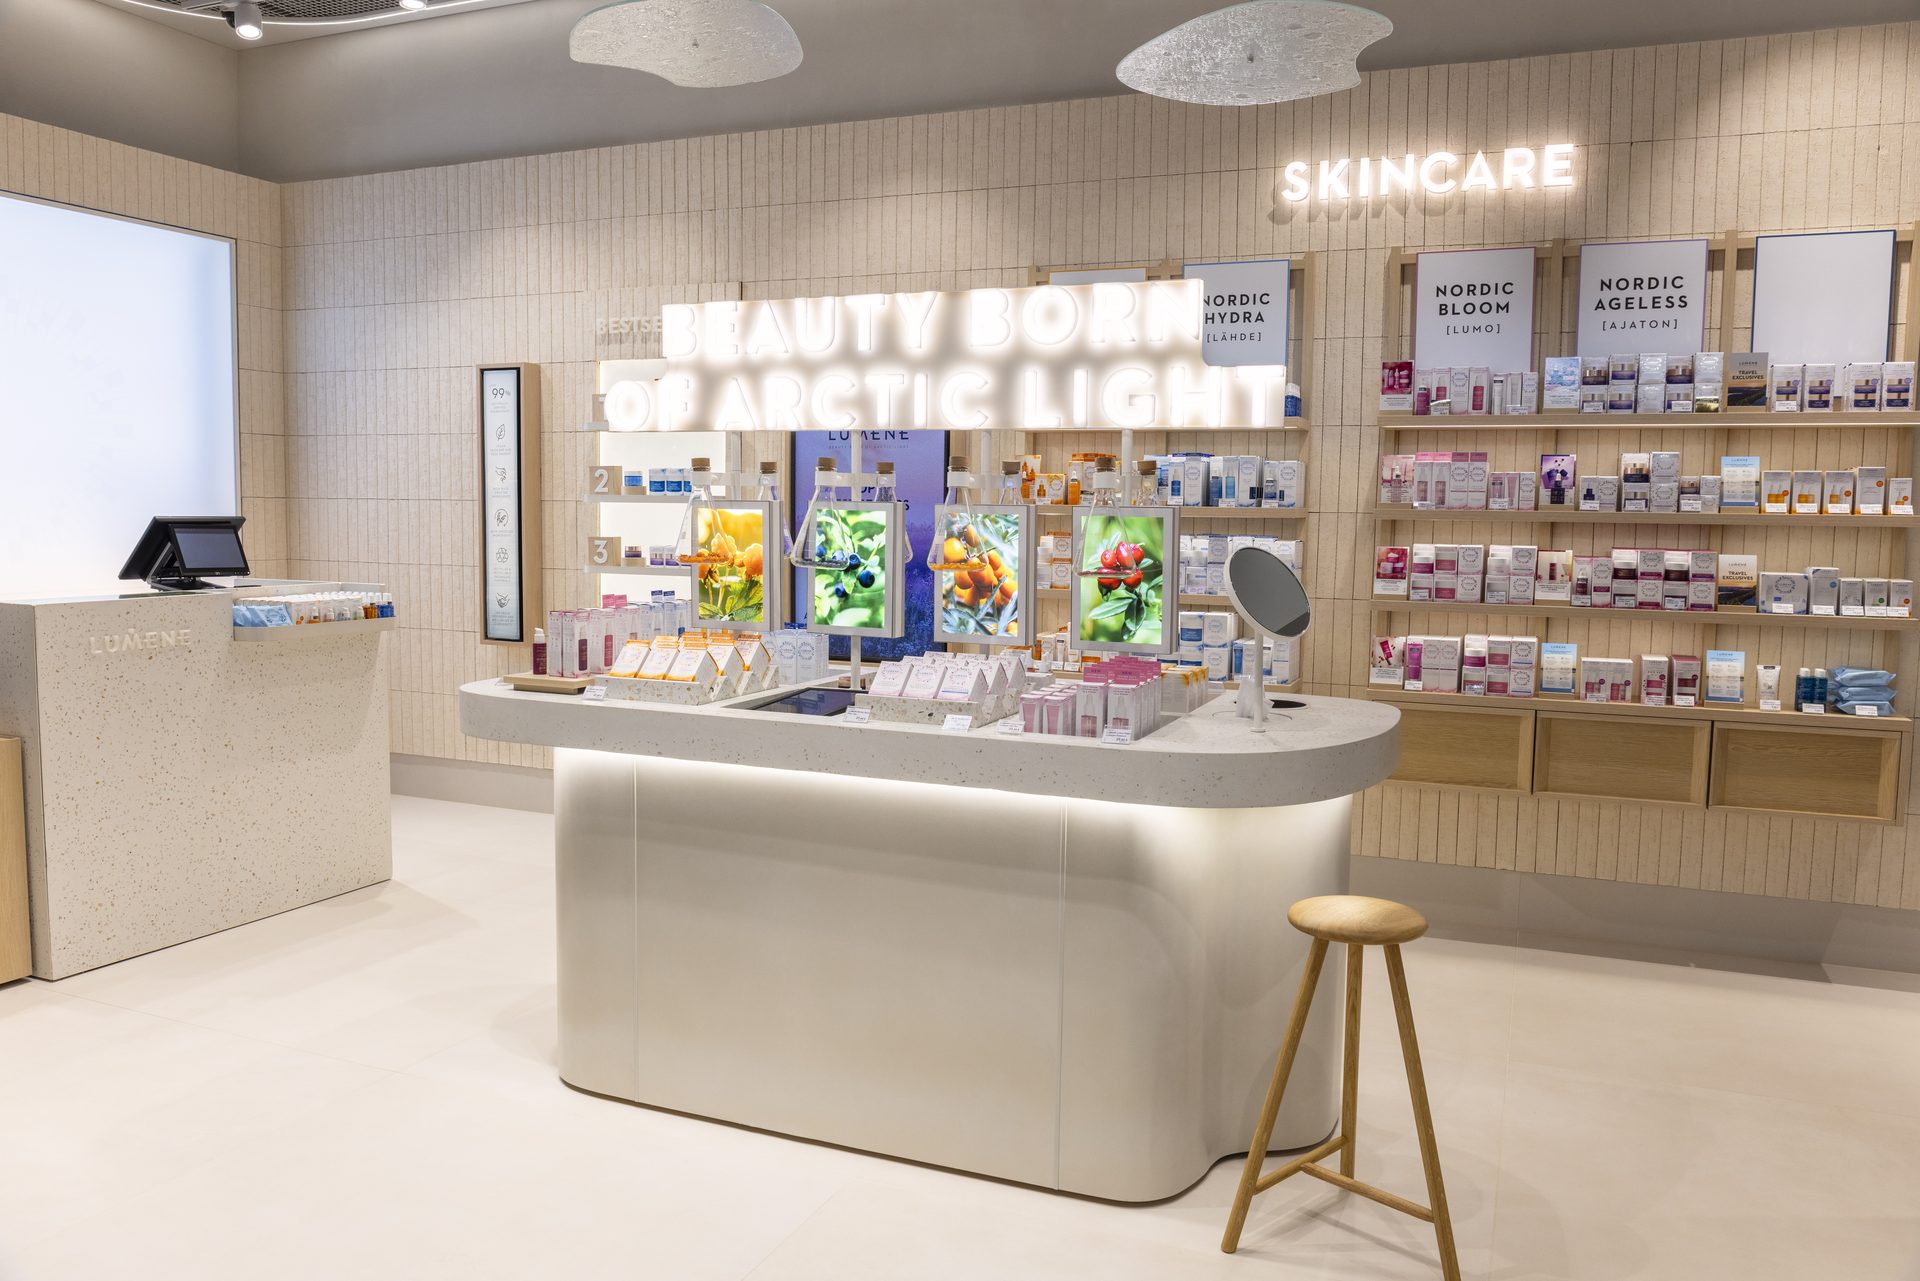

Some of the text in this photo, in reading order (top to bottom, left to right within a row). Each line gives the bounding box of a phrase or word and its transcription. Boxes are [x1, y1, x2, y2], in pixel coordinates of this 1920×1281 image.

[1281, 143, 1574, 201] SKINCARE
[1435, 282, 1514, 298] NORDIC
[1600, 276, 1684, 292] NORDIC
[1203, 293, 1271, 307] NORDIC
[1594, 295, 1688, 311] AGELESS
[1439, 301, 1510, 316] BLOOM
[662, 282, 1201, 358] BEAUTY BORN
[1204, 311, 1265, 325] HYDRA
[1602, 318, 1678, 331] [AJATON]
[1206, 331, 1262, 343] [LÄHDE]
[1446, 323, 1501, 335] [LUMO]
[604, 365, 1285, 430] OF ARCTIC LIGHT
[594, 468, 609, 493] 2
[593, 539, 608, 564] 3
[89, 628, 192, 654] LUMENE
